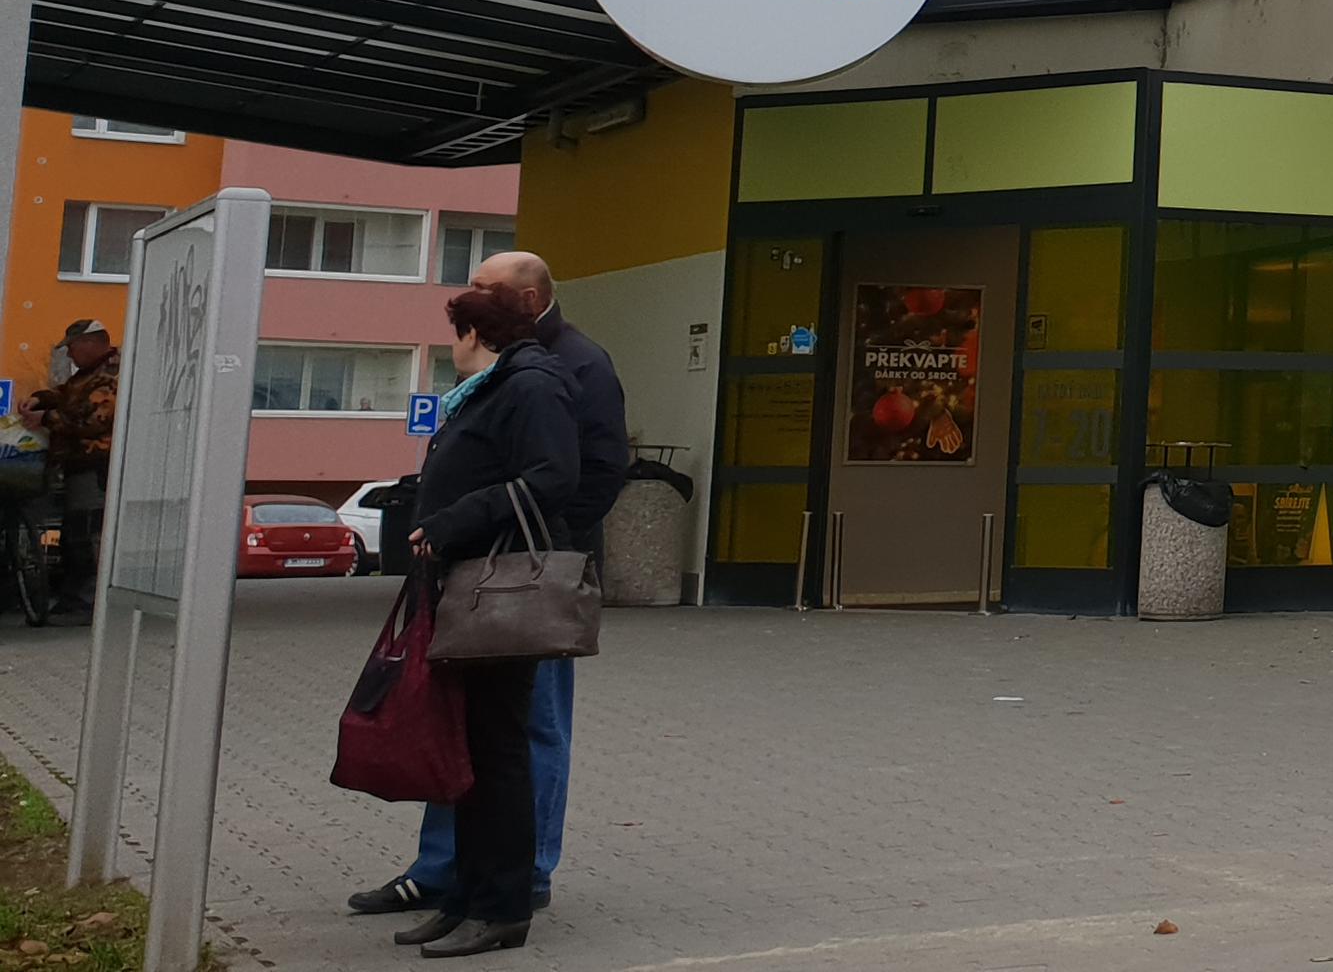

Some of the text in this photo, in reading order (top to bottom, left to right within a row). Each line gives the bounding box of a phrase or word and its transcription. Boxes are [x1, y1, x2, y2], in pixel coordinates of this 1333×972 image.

[865, 347, 968, 369] PŘEKVAPTE
[911, 371, 926, 380] OD
[414, 398, 433, 423] P
